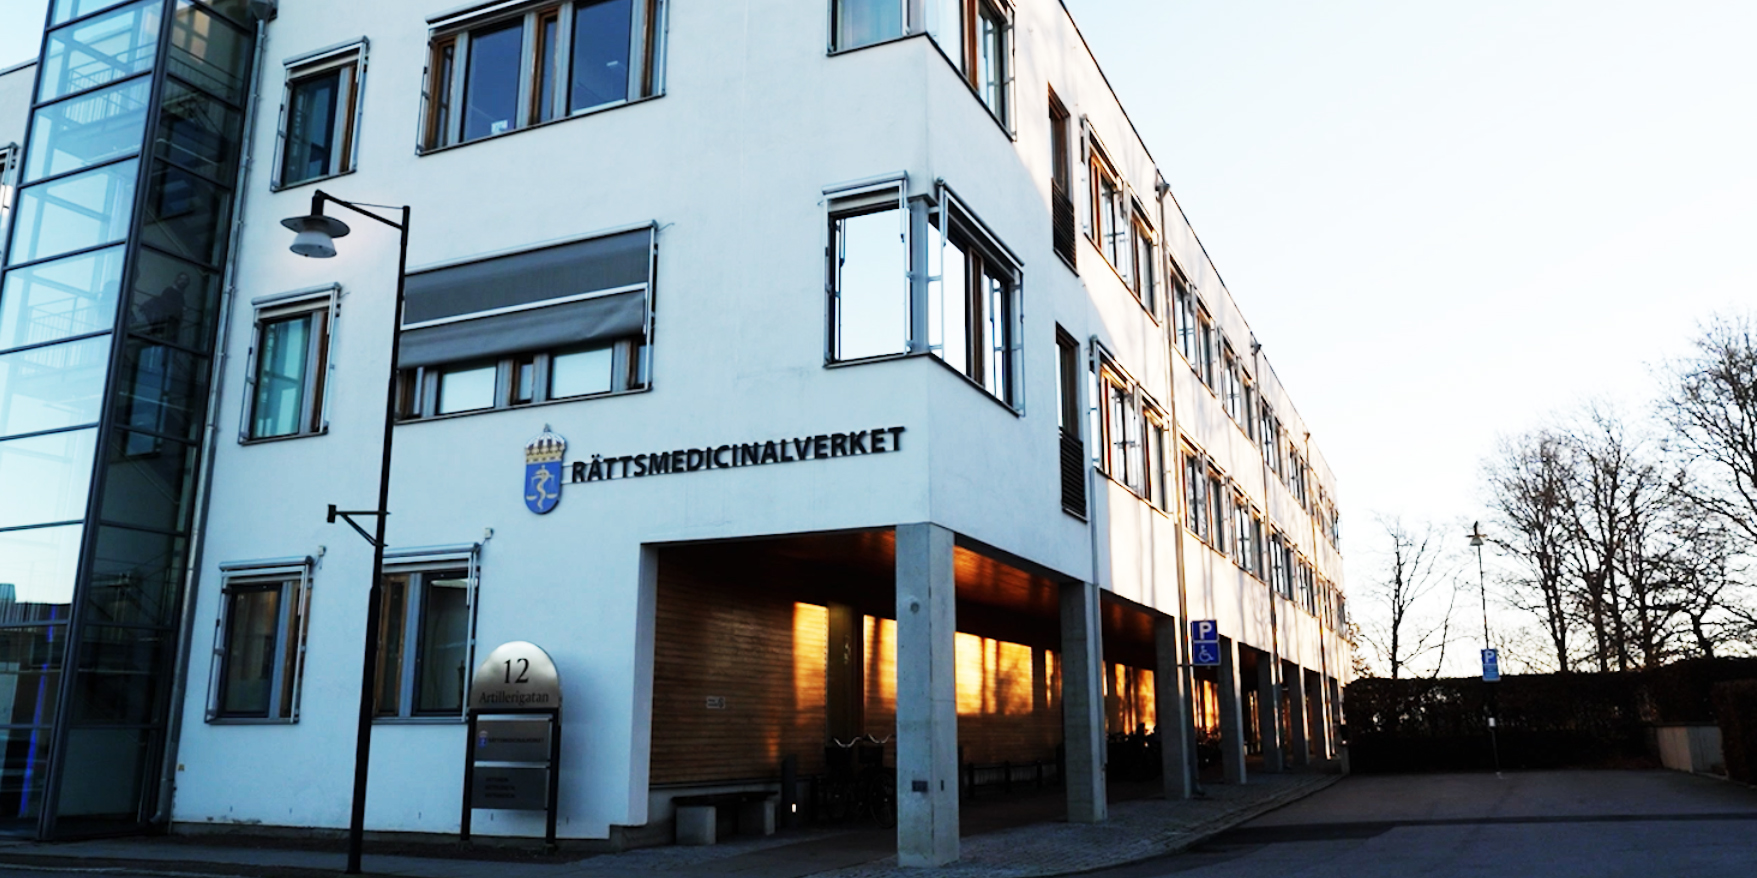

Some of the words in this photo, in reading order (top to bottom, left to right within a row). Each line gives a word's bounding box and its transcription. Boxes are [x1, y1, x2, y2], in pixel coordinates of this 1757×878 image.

[571, 426, 906, 483] RÄTTSMEDICINALVERKET
[1199, 622, 1212, 640] P
[1485, 650, 1495, 663] P
[503, 657, 529, 684] 12
[479, 691, 549, 705] Artillerigatan
